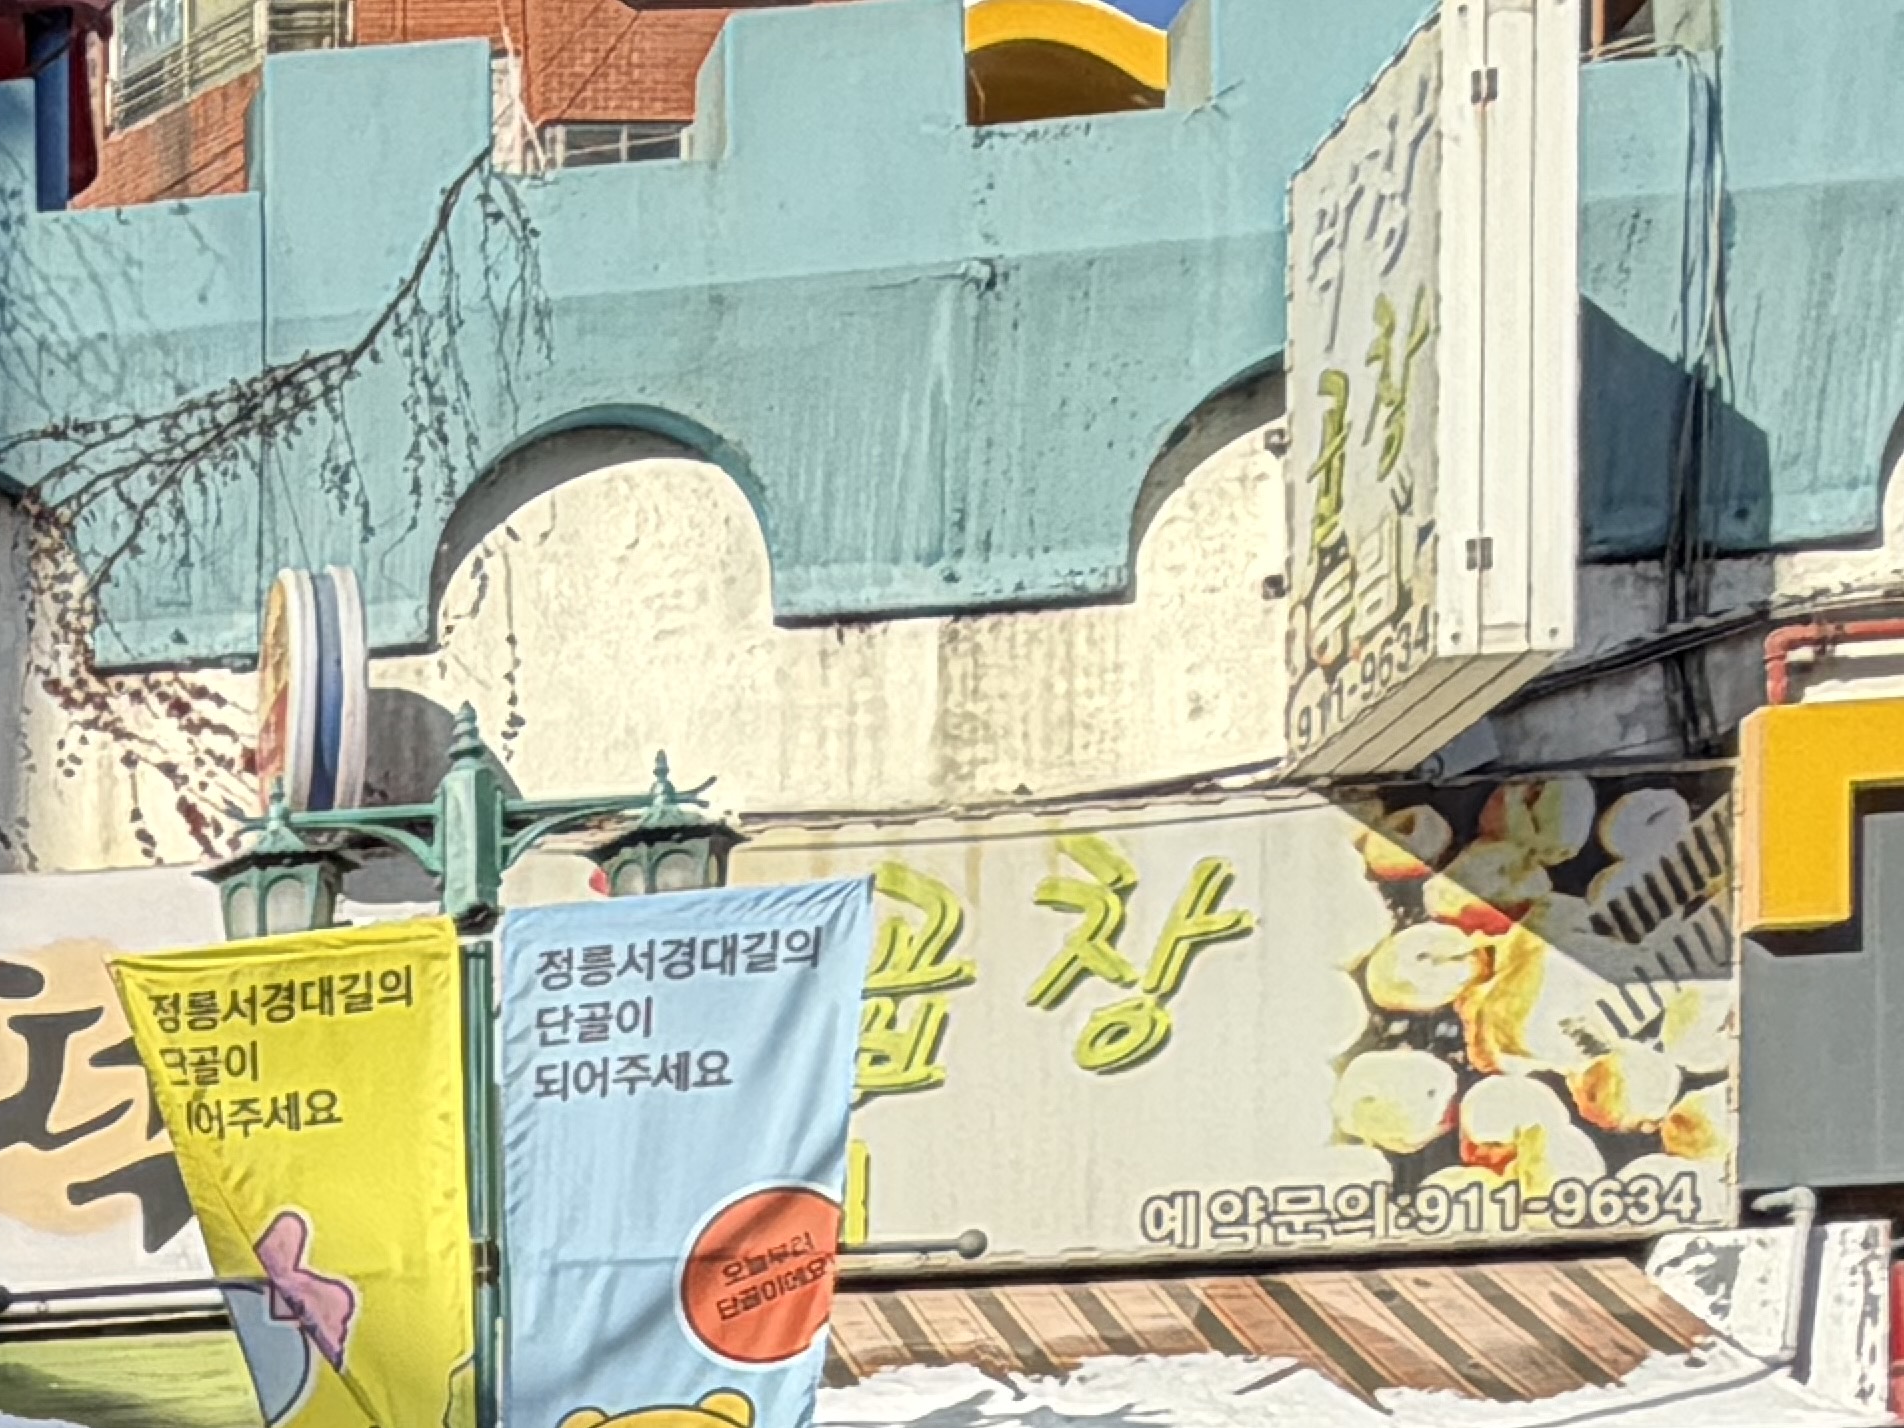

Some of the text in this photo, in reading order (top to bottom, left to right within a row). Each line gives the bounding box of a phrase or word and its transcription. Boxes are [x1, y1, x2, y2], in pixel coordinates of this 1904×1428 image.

[1297, 603, 1429, 752] 911-9634
[535, 926, 824, 991] 정릉서경대길의
[149, 965, 413, 1034] 정릉서경대길의
[534, 997, 654, 1048] 단골이
[533, 1050, 733, 1102] 되어주세요
